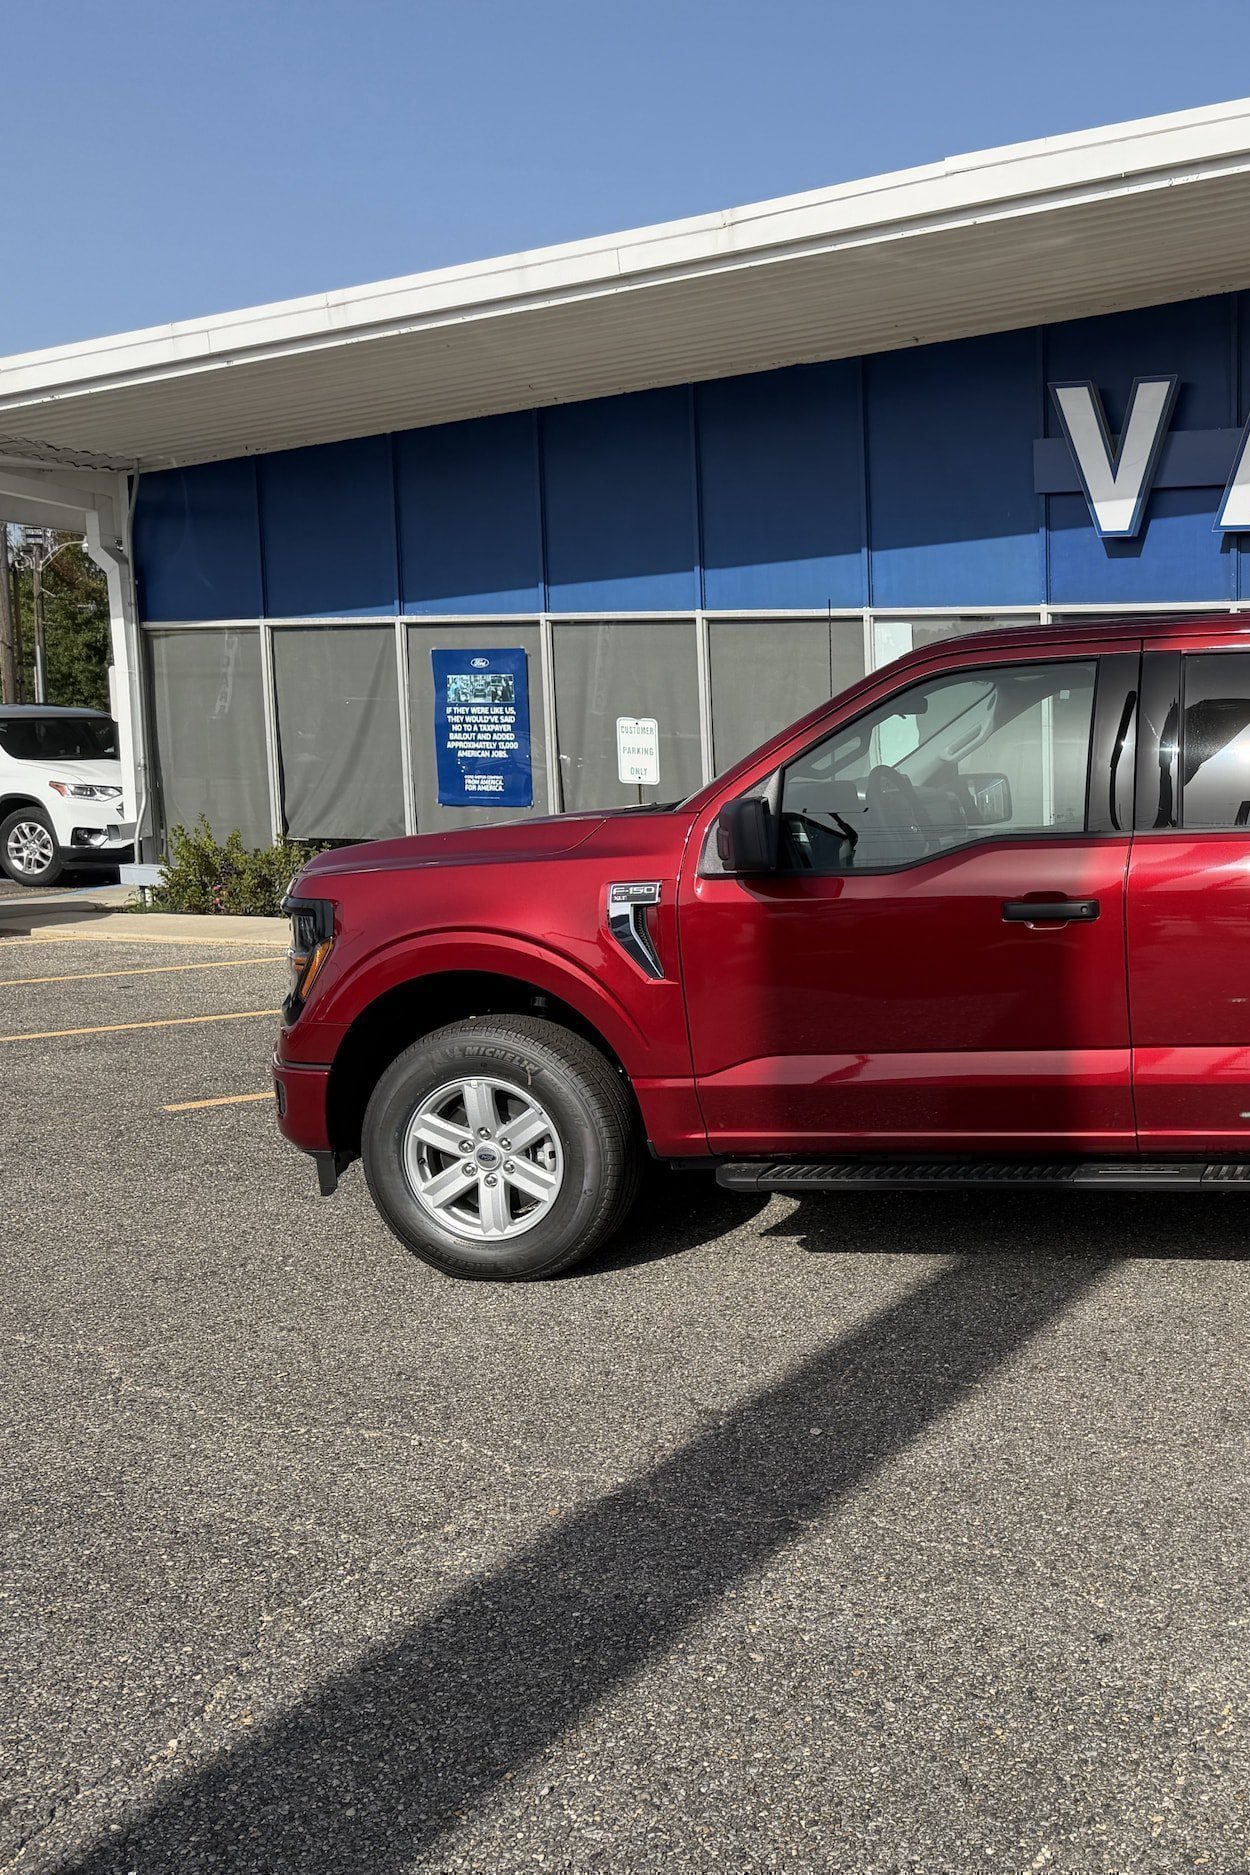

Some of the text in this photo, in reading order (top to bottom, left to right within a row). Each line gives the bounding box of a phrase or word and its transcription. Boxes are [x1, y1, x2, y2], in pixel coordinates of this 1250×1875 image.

[620, 725, 654, 735] CUSTOMER
[622, 746, 654, 756] PARKING
[630, 767, 648, 776] ONLY
[613, 886, 655, 895] F-150
[465, 1046, 540, 1073] MICHELIN
